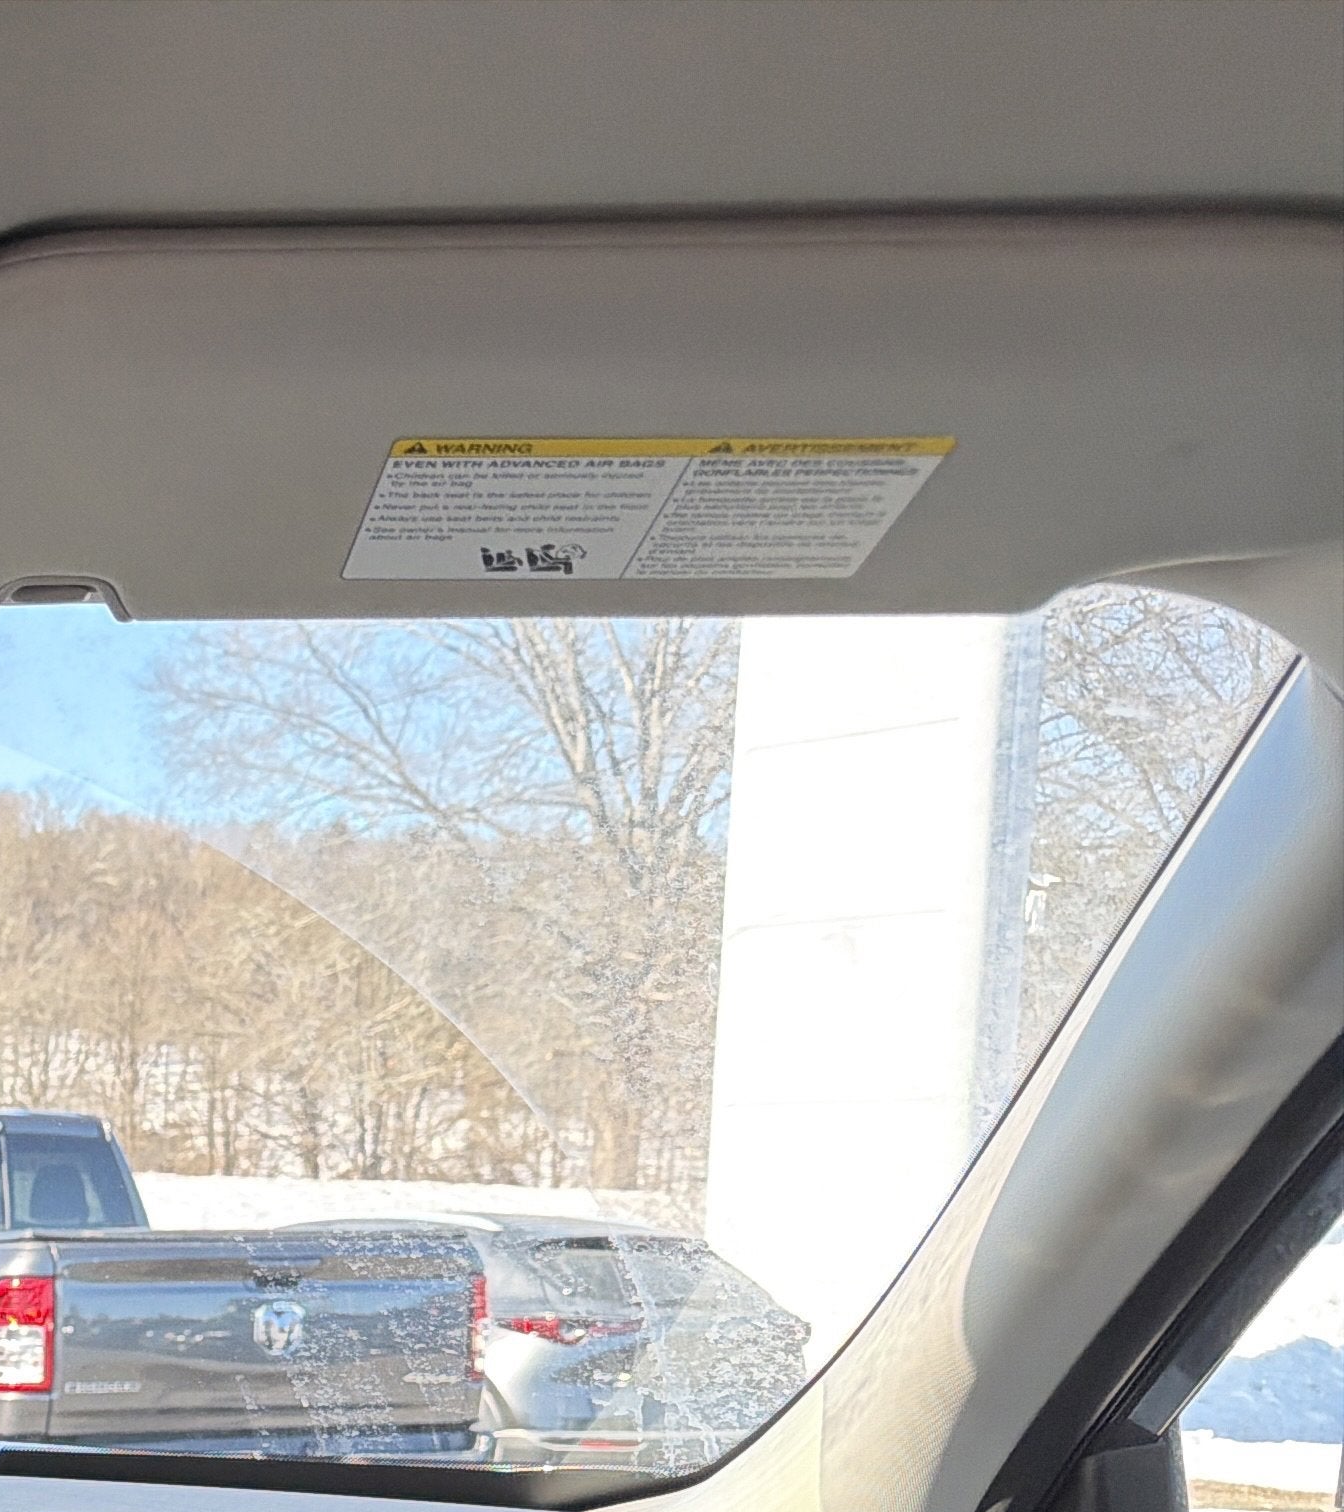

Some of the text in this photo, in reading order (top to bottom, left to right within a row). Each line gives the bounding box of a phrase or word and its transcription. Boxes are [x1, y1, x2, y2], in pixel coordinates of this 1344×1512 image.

[435, 443, 532, 455] WARNING
[392, 460, 665, 468] EVEN WITH ADVANCED AIR BAGS
